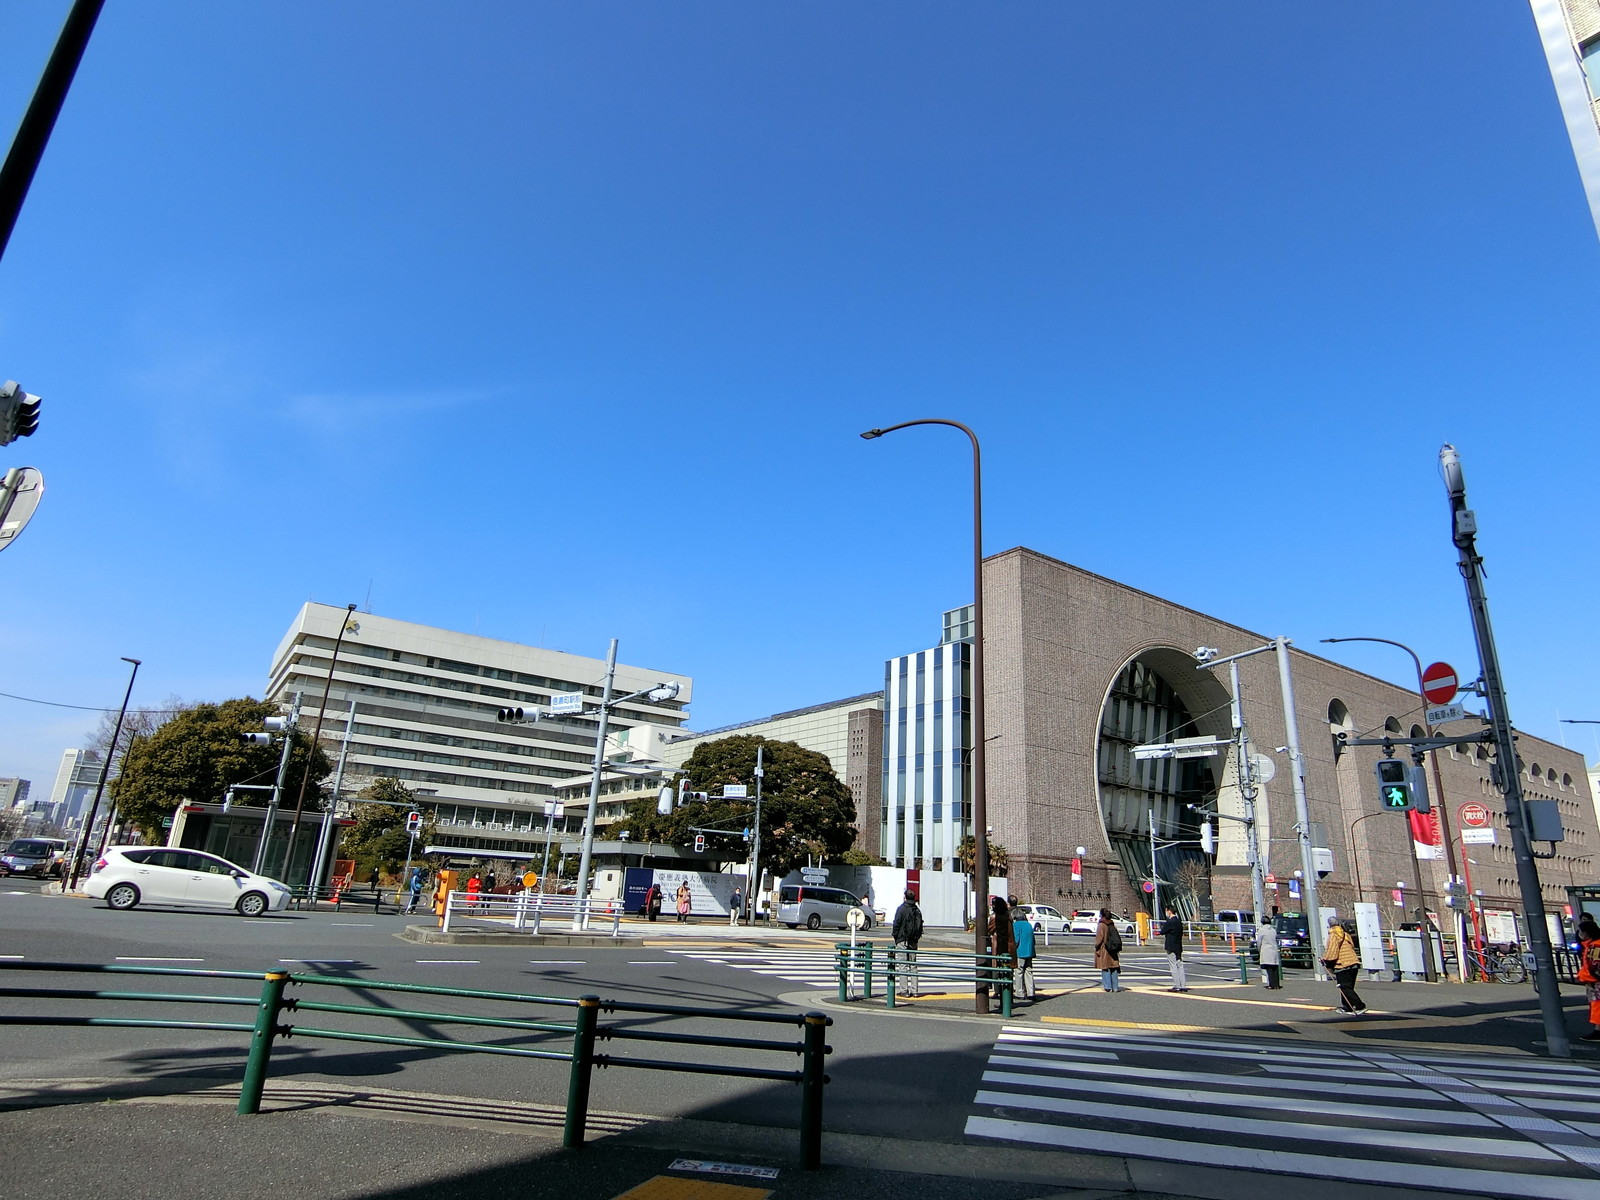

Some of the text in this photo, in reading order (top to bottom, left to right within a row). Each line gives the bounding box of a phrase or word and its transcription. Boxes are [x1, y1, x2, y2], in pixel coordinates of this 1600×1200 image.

[1428, 707, 1461, 721] 自転車を除く
